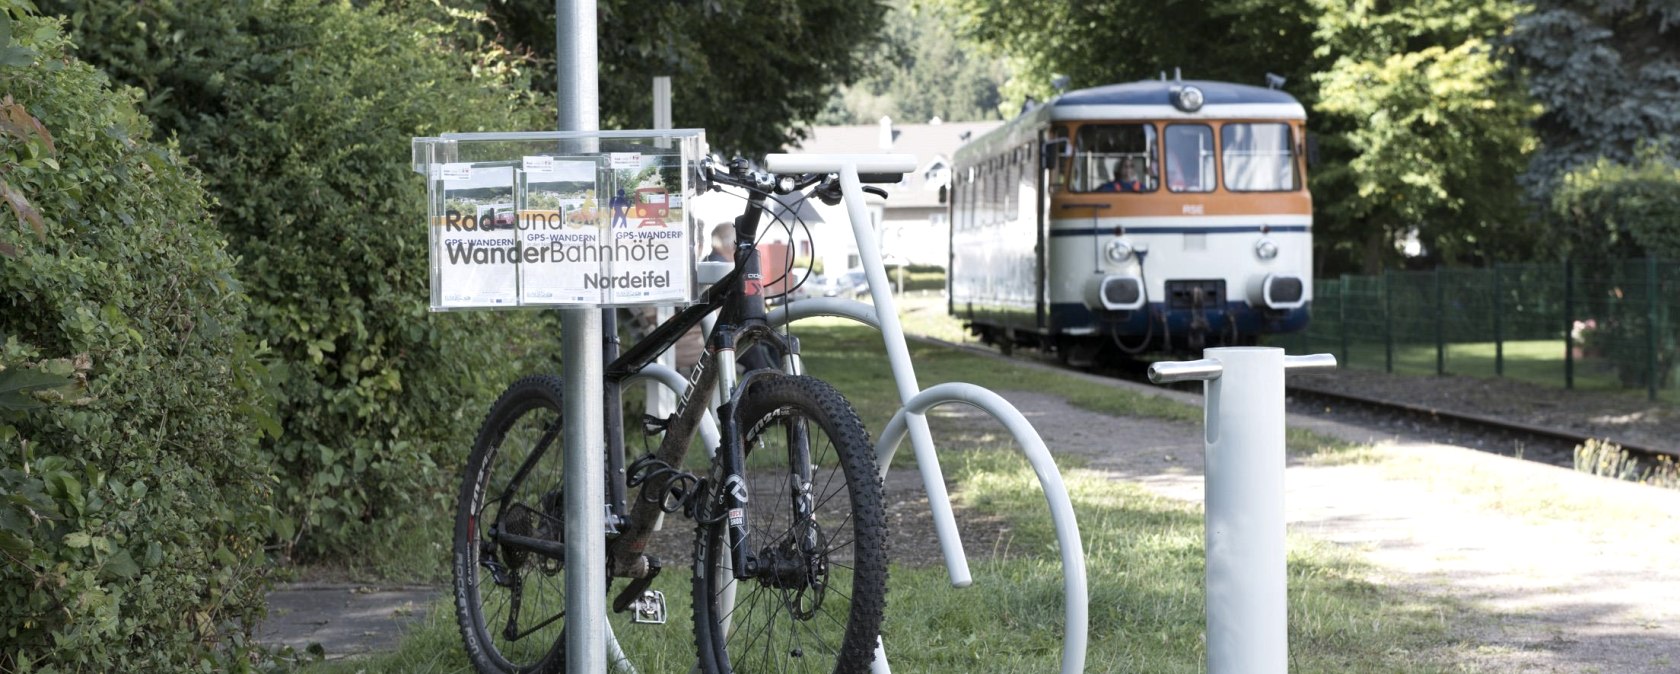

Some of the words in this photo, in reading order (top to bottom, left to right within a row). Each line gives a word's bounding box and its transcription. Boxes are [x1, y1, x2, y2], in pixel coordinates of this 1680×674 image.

[516, 206, 562, 231] und
[526, 233, 596, 242] GPS-WANDERN
[446, 236, 669, 266] WanderBahnhöfe
[583, 270, 670, 290] Nordeifel
